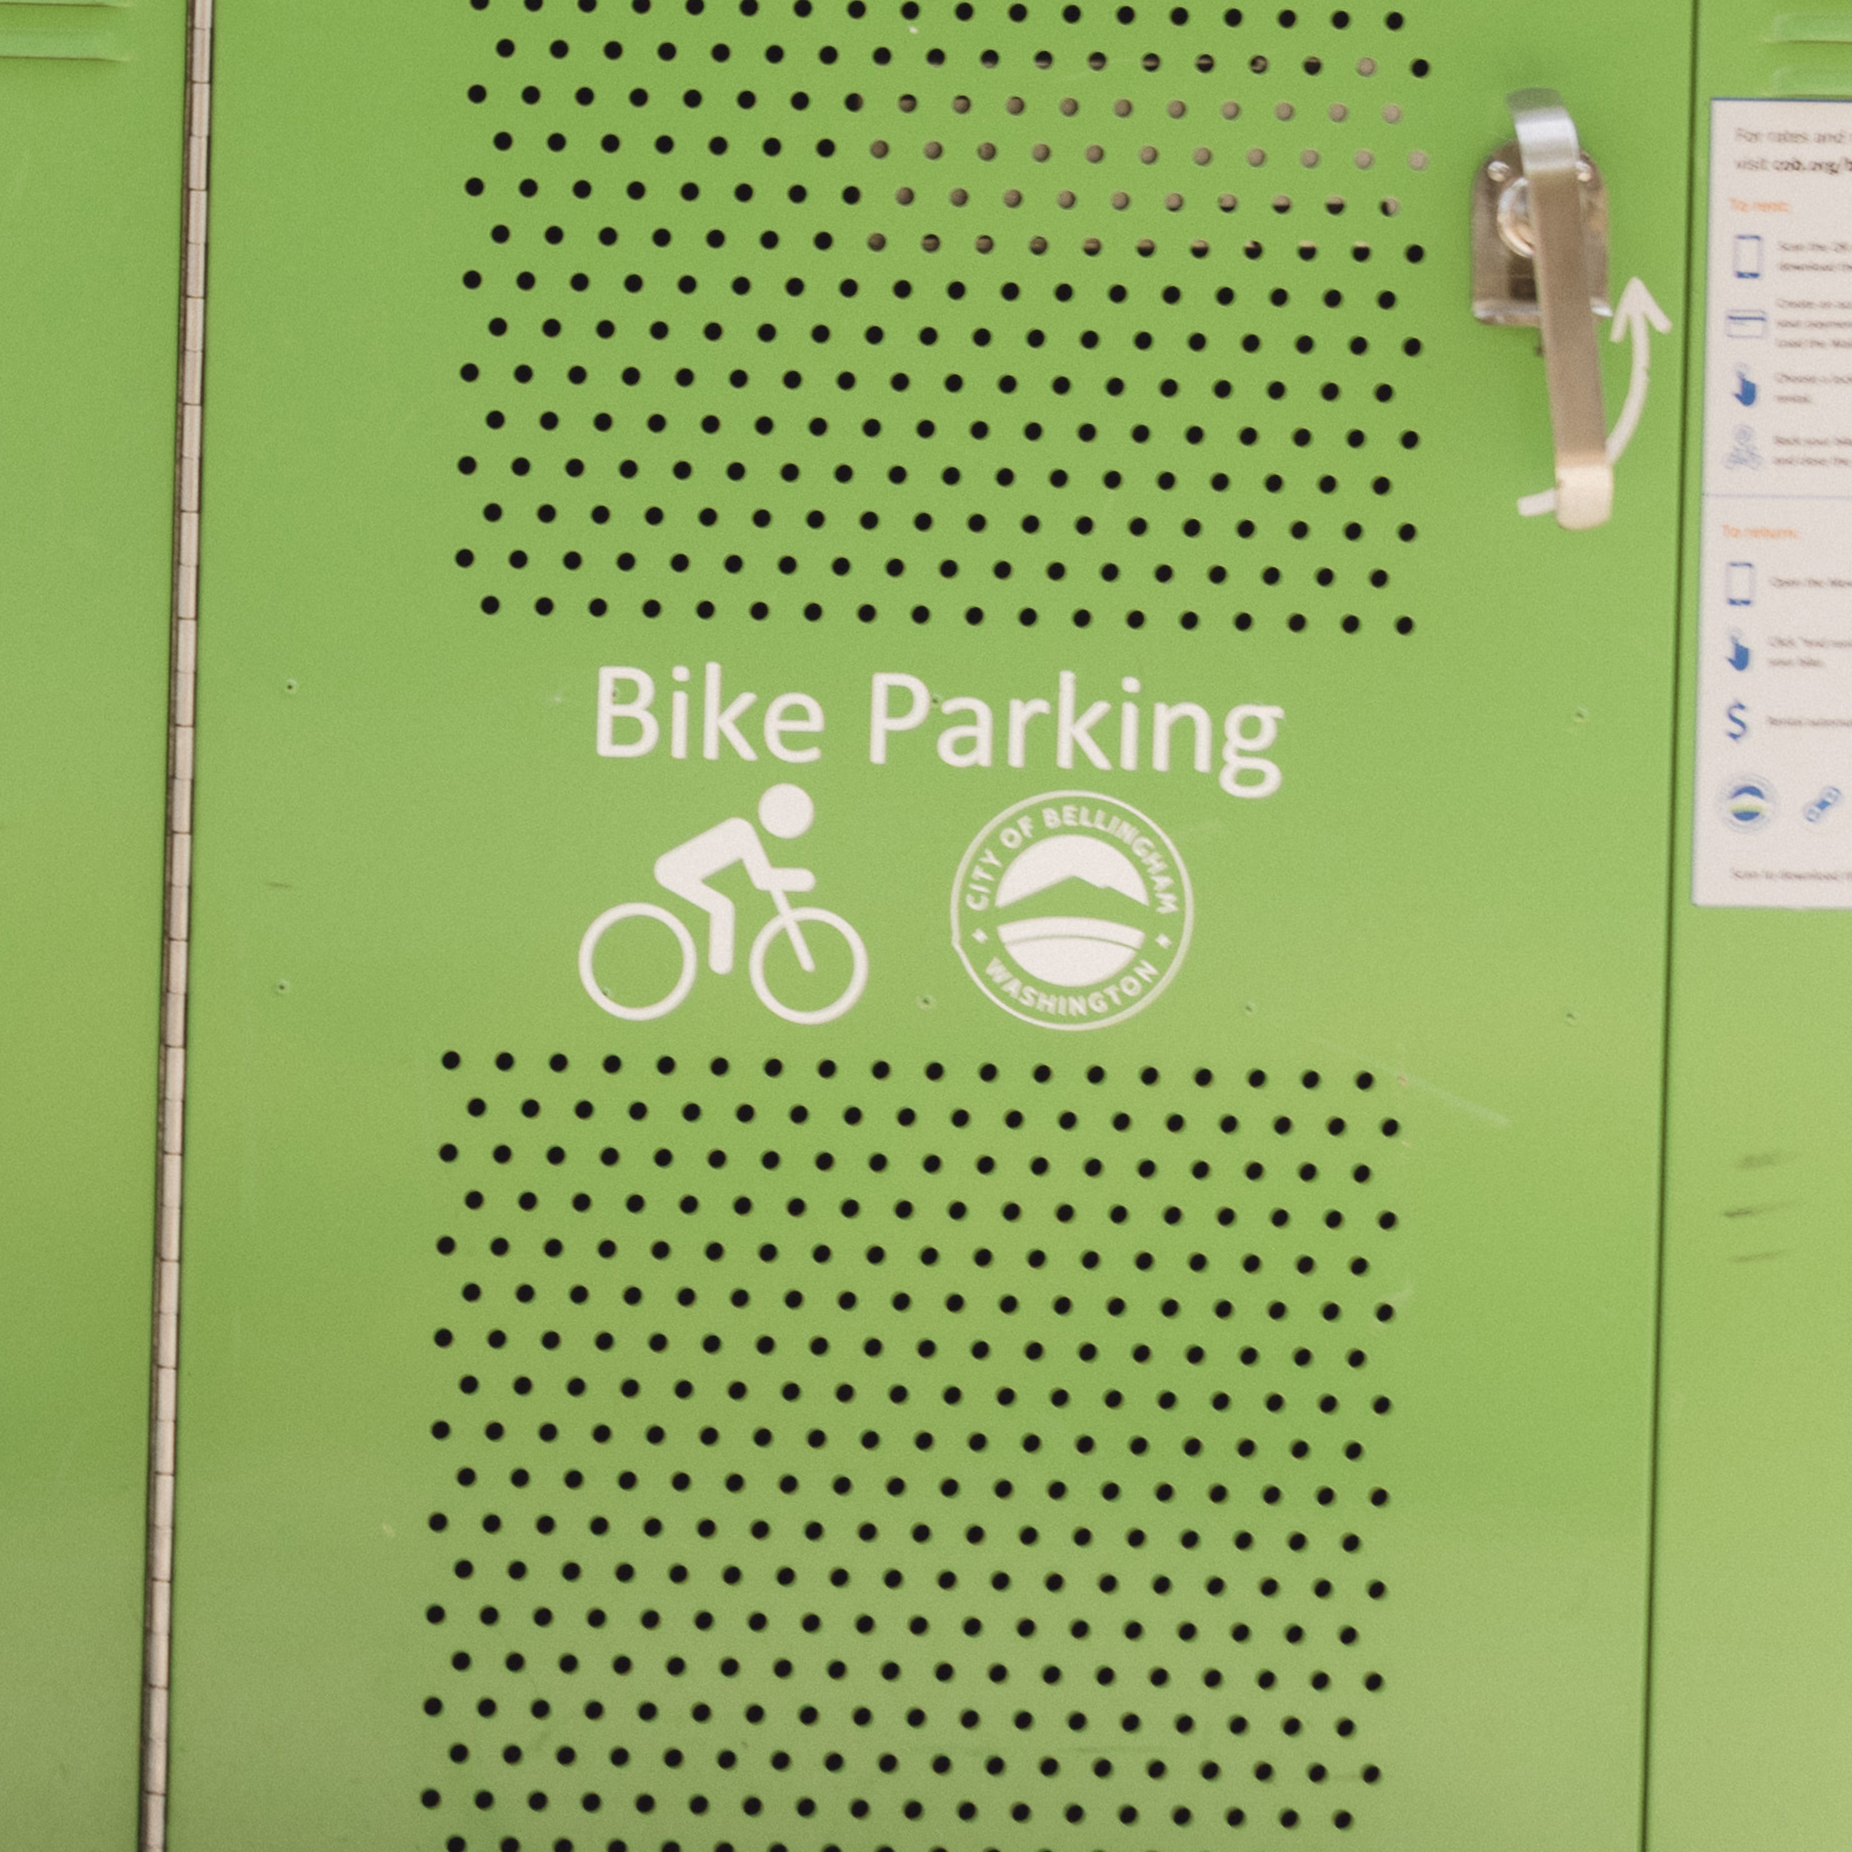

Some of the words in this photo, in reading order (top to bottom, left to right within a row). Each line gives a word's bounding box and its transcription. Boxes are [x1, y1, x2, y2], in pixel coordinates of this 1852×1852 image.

[594, 662, 826, 764] Bike
[867, 670, 1285, 800] Parking
[966, 848, 1004, 912] CITY
[999, 815, 1035, 850] OF
[1042, 804, 1180, 915] BELLINGHAM
[985, 956, 1160, 1018] WASHINGTON
